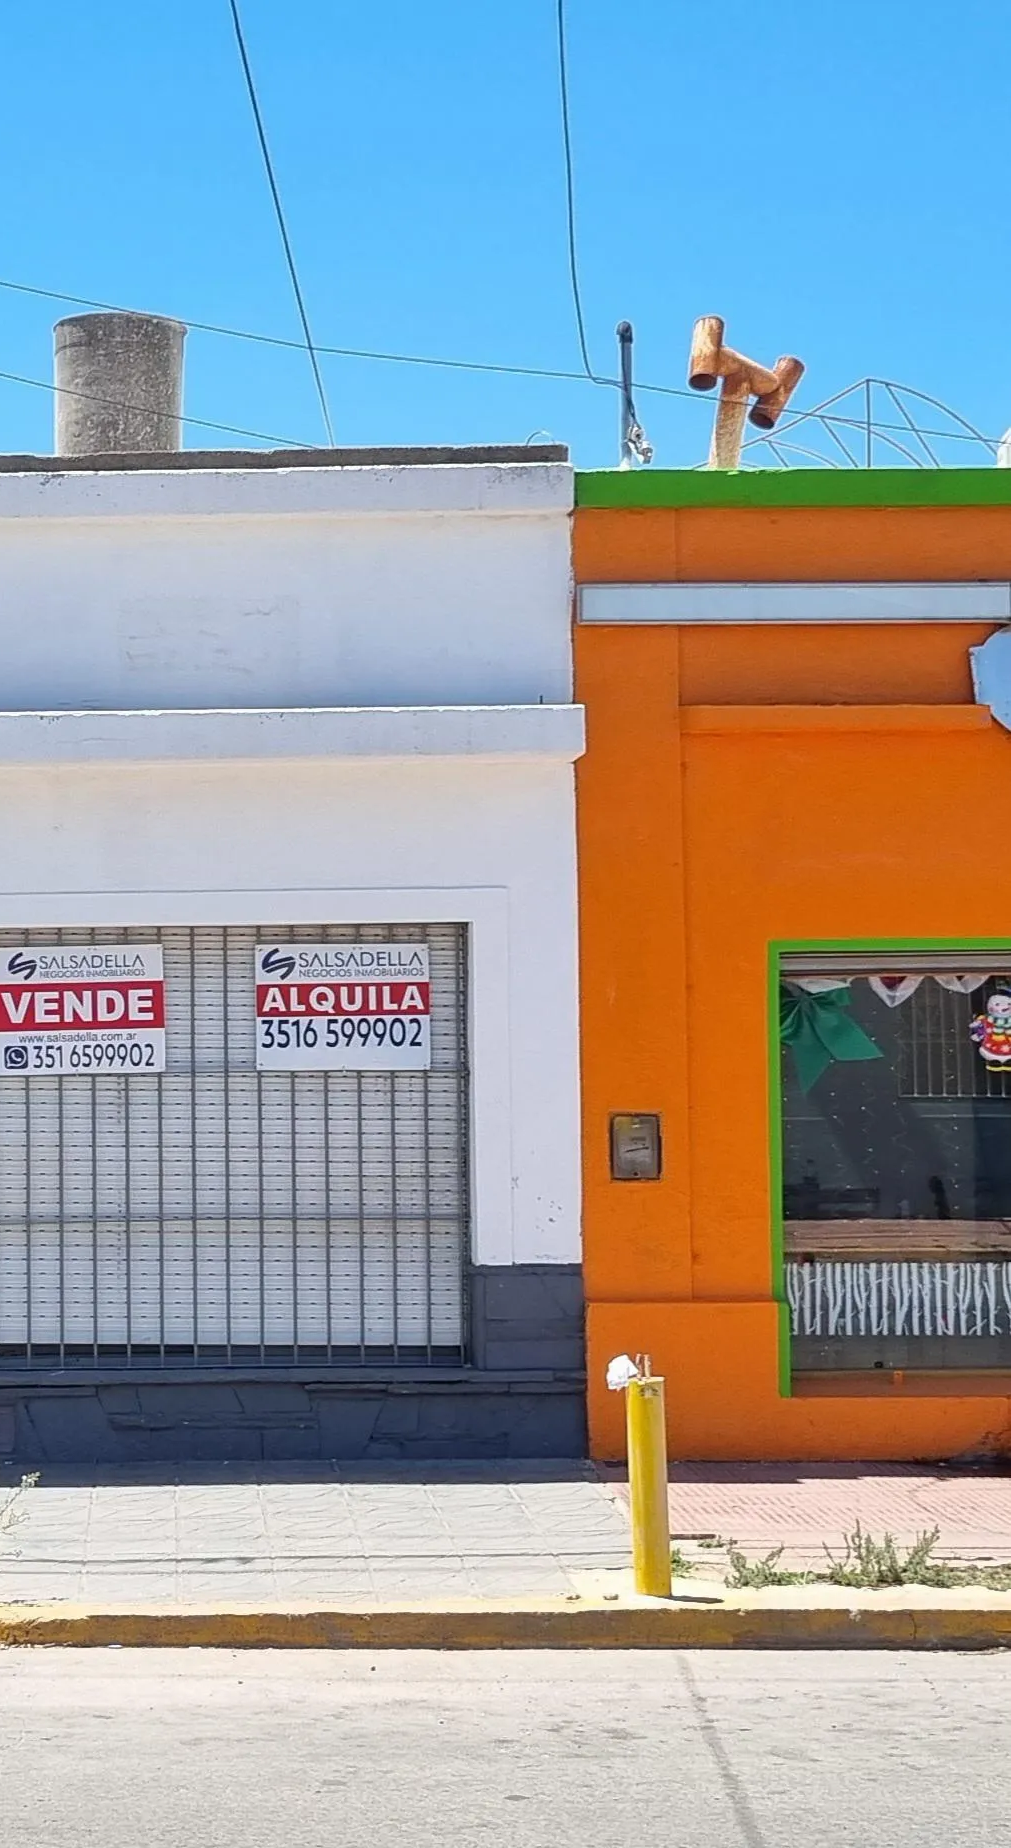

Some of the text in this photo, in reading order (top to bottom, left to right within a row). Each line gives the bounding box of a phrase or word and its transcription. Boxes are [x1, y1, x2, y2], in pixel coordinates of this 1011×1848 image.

[39, 954, 145, 970] SALSADELLA
[299, 951, 423, 968] SALSADELLA
[40, 970, 85, 979] NEGOCIOS
[299, 967, 425, 978] NEGOCIOS INMOBILIARIOS
[0, 989, 154, 1023] VENDE
[262, 985, 425, 1014] ALQUILA
[18, 1032, 137, 1043] www.salsadella.com.ar
[261, 1018, 422, 1048] 3516 599902
